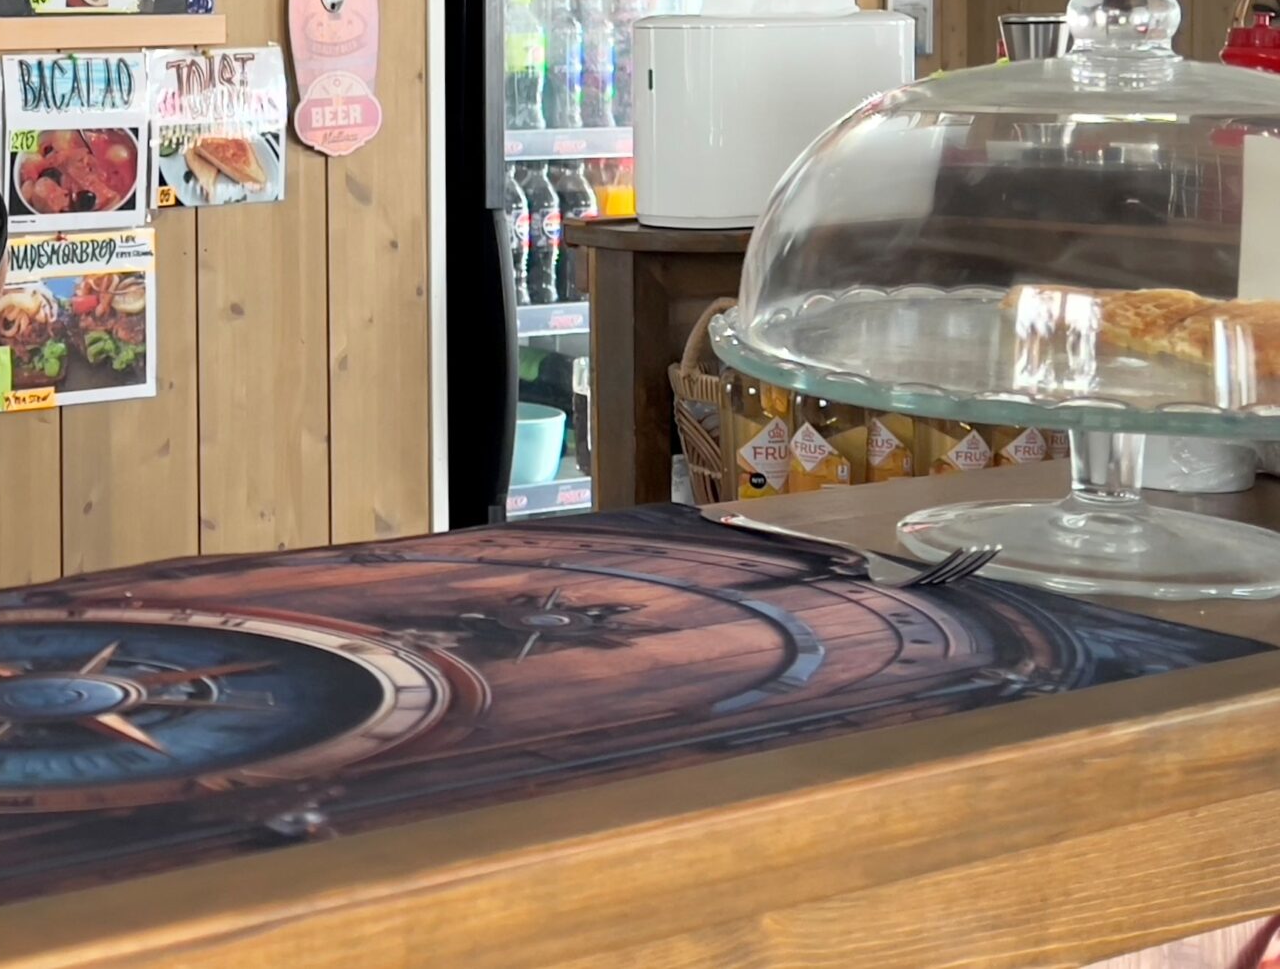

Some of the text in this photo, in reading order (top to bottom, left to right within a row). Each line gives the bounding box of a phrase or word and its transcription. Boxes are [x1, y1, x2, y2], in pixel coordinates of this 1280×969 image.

[19, 57, 135, 112] BACALAO
[311, 104, 362, 128] BEER
[9, 238, 117, 272] NADESMØRBRØD
[752, 445, 788, 460] FRU
[794, 441, 826, 455] FRUS
[867, 438, 894, 450] RUS
